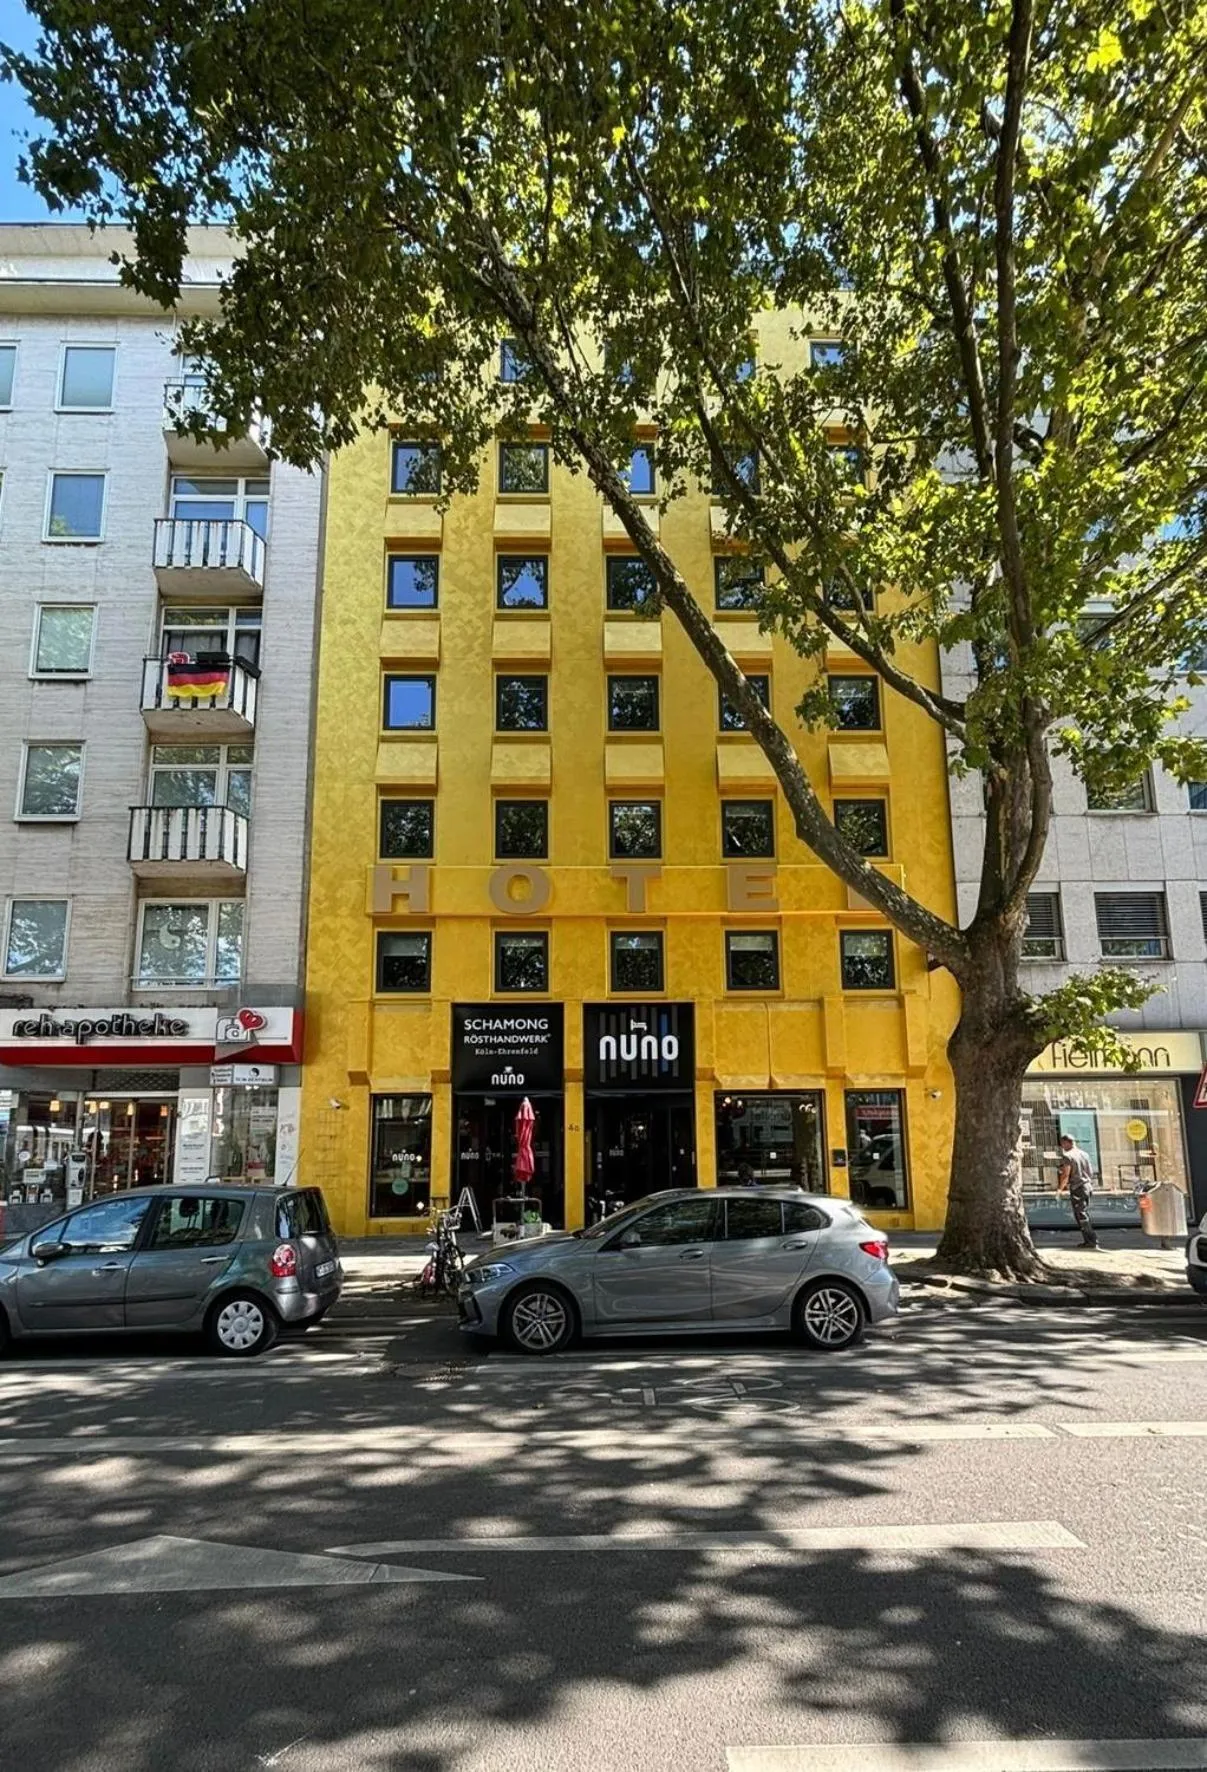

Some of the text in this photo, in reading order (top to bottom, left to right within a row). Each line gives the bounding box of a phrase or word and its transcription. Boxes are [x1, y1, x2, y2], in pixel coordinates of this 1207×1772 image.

[464, 1019, 549, 1030] SCHAMONG
[475, 1047, 539, 1055] Köln-Ehrenfeld
[599, 1034, 679, 1061] nuno
[491, 1074, 525, 1085] nuno
